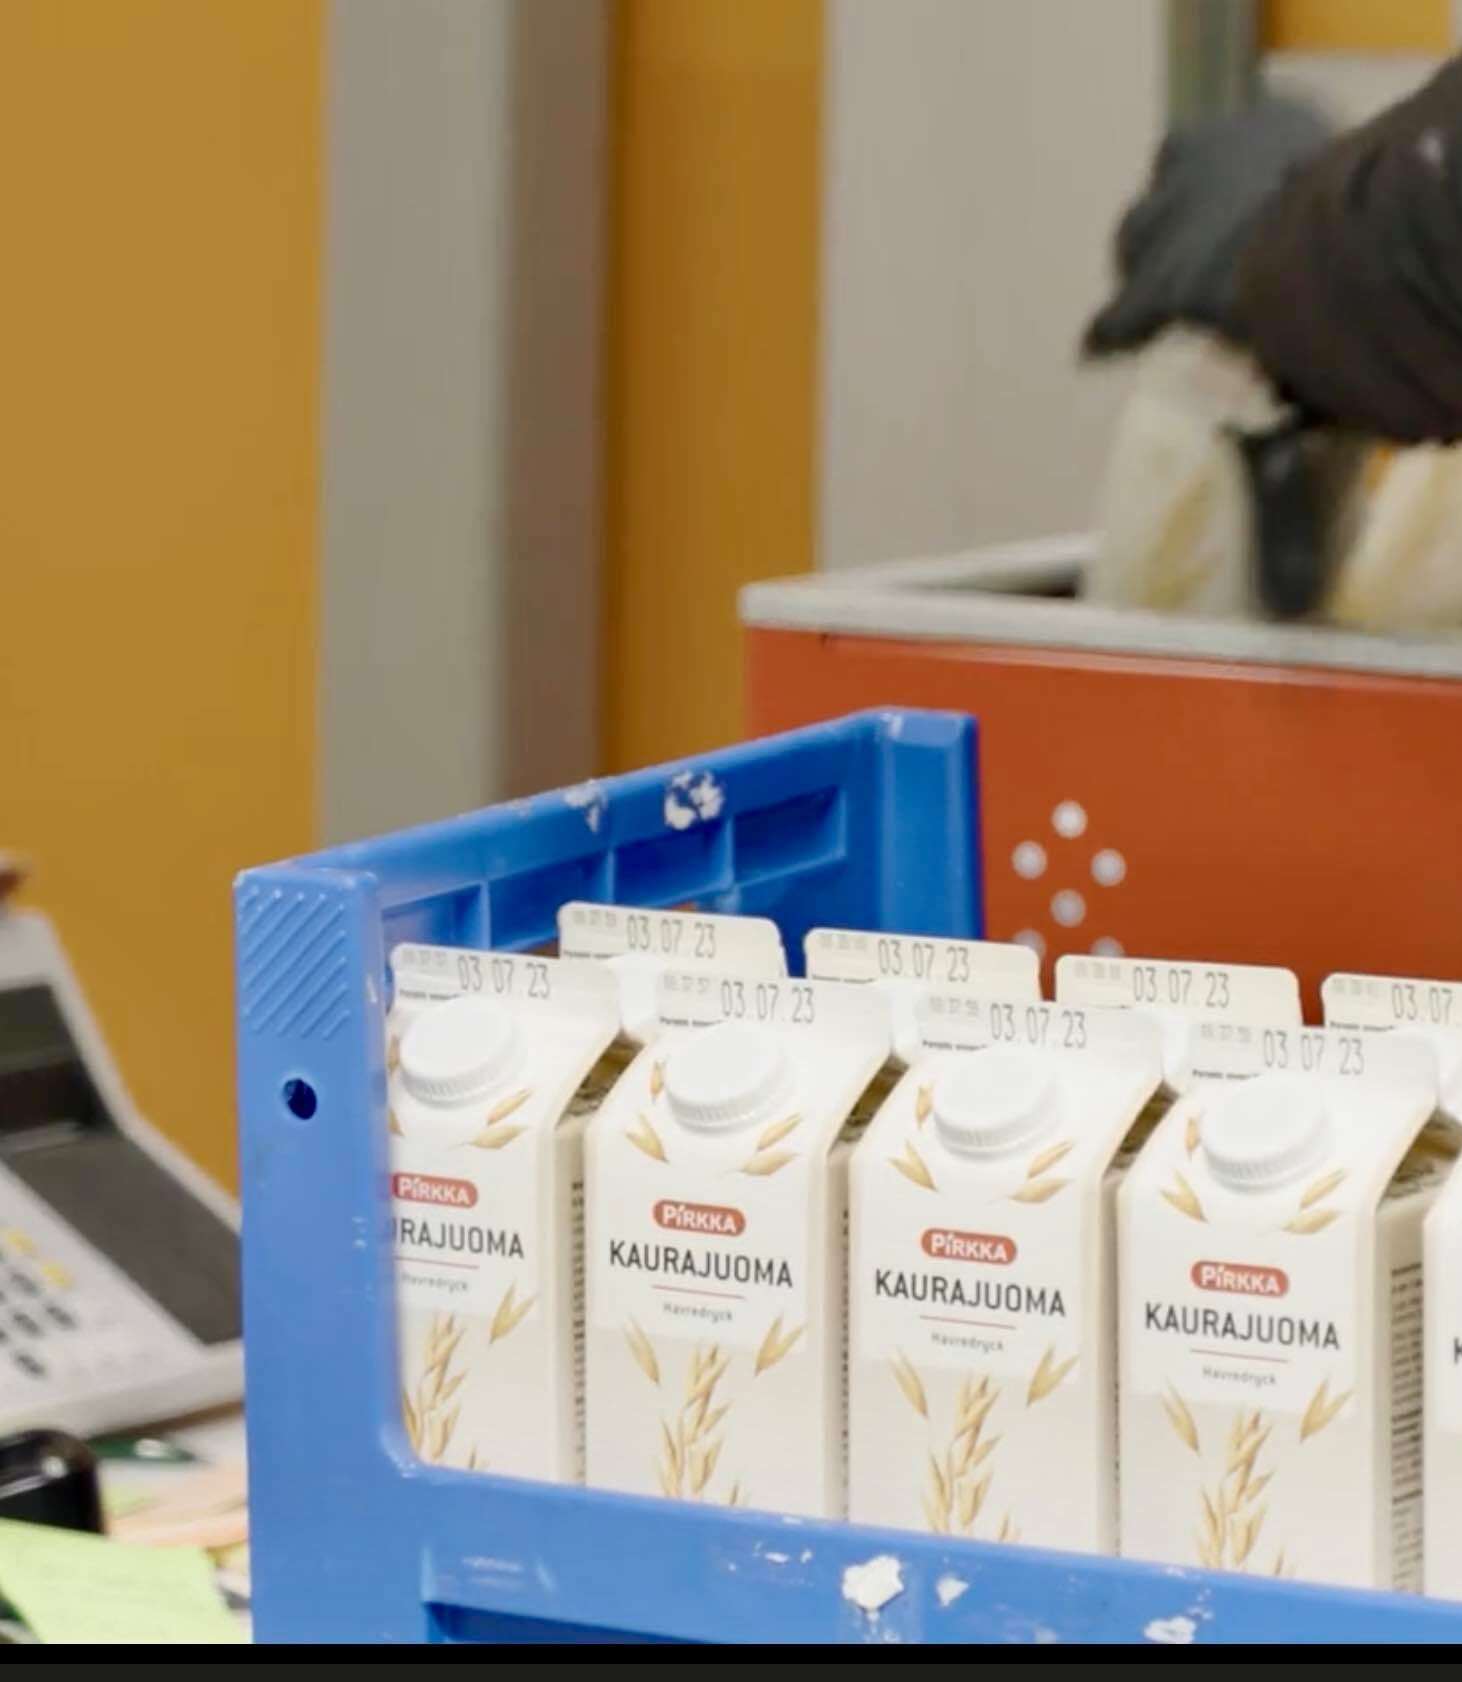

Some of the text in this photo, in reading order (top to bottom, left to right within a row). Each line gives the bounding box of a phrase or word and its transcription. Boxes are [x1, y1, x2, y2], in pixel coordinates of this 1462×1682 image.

[392, 1218, 525, 1260] RAJUOMA
[609, 1239, 793, 1288] KAURAJUOMA
[875, 1268, 1066, 1317] KAURAJUOMA
[1145, 1301, 1340, 1350] KAURAJUOMA
